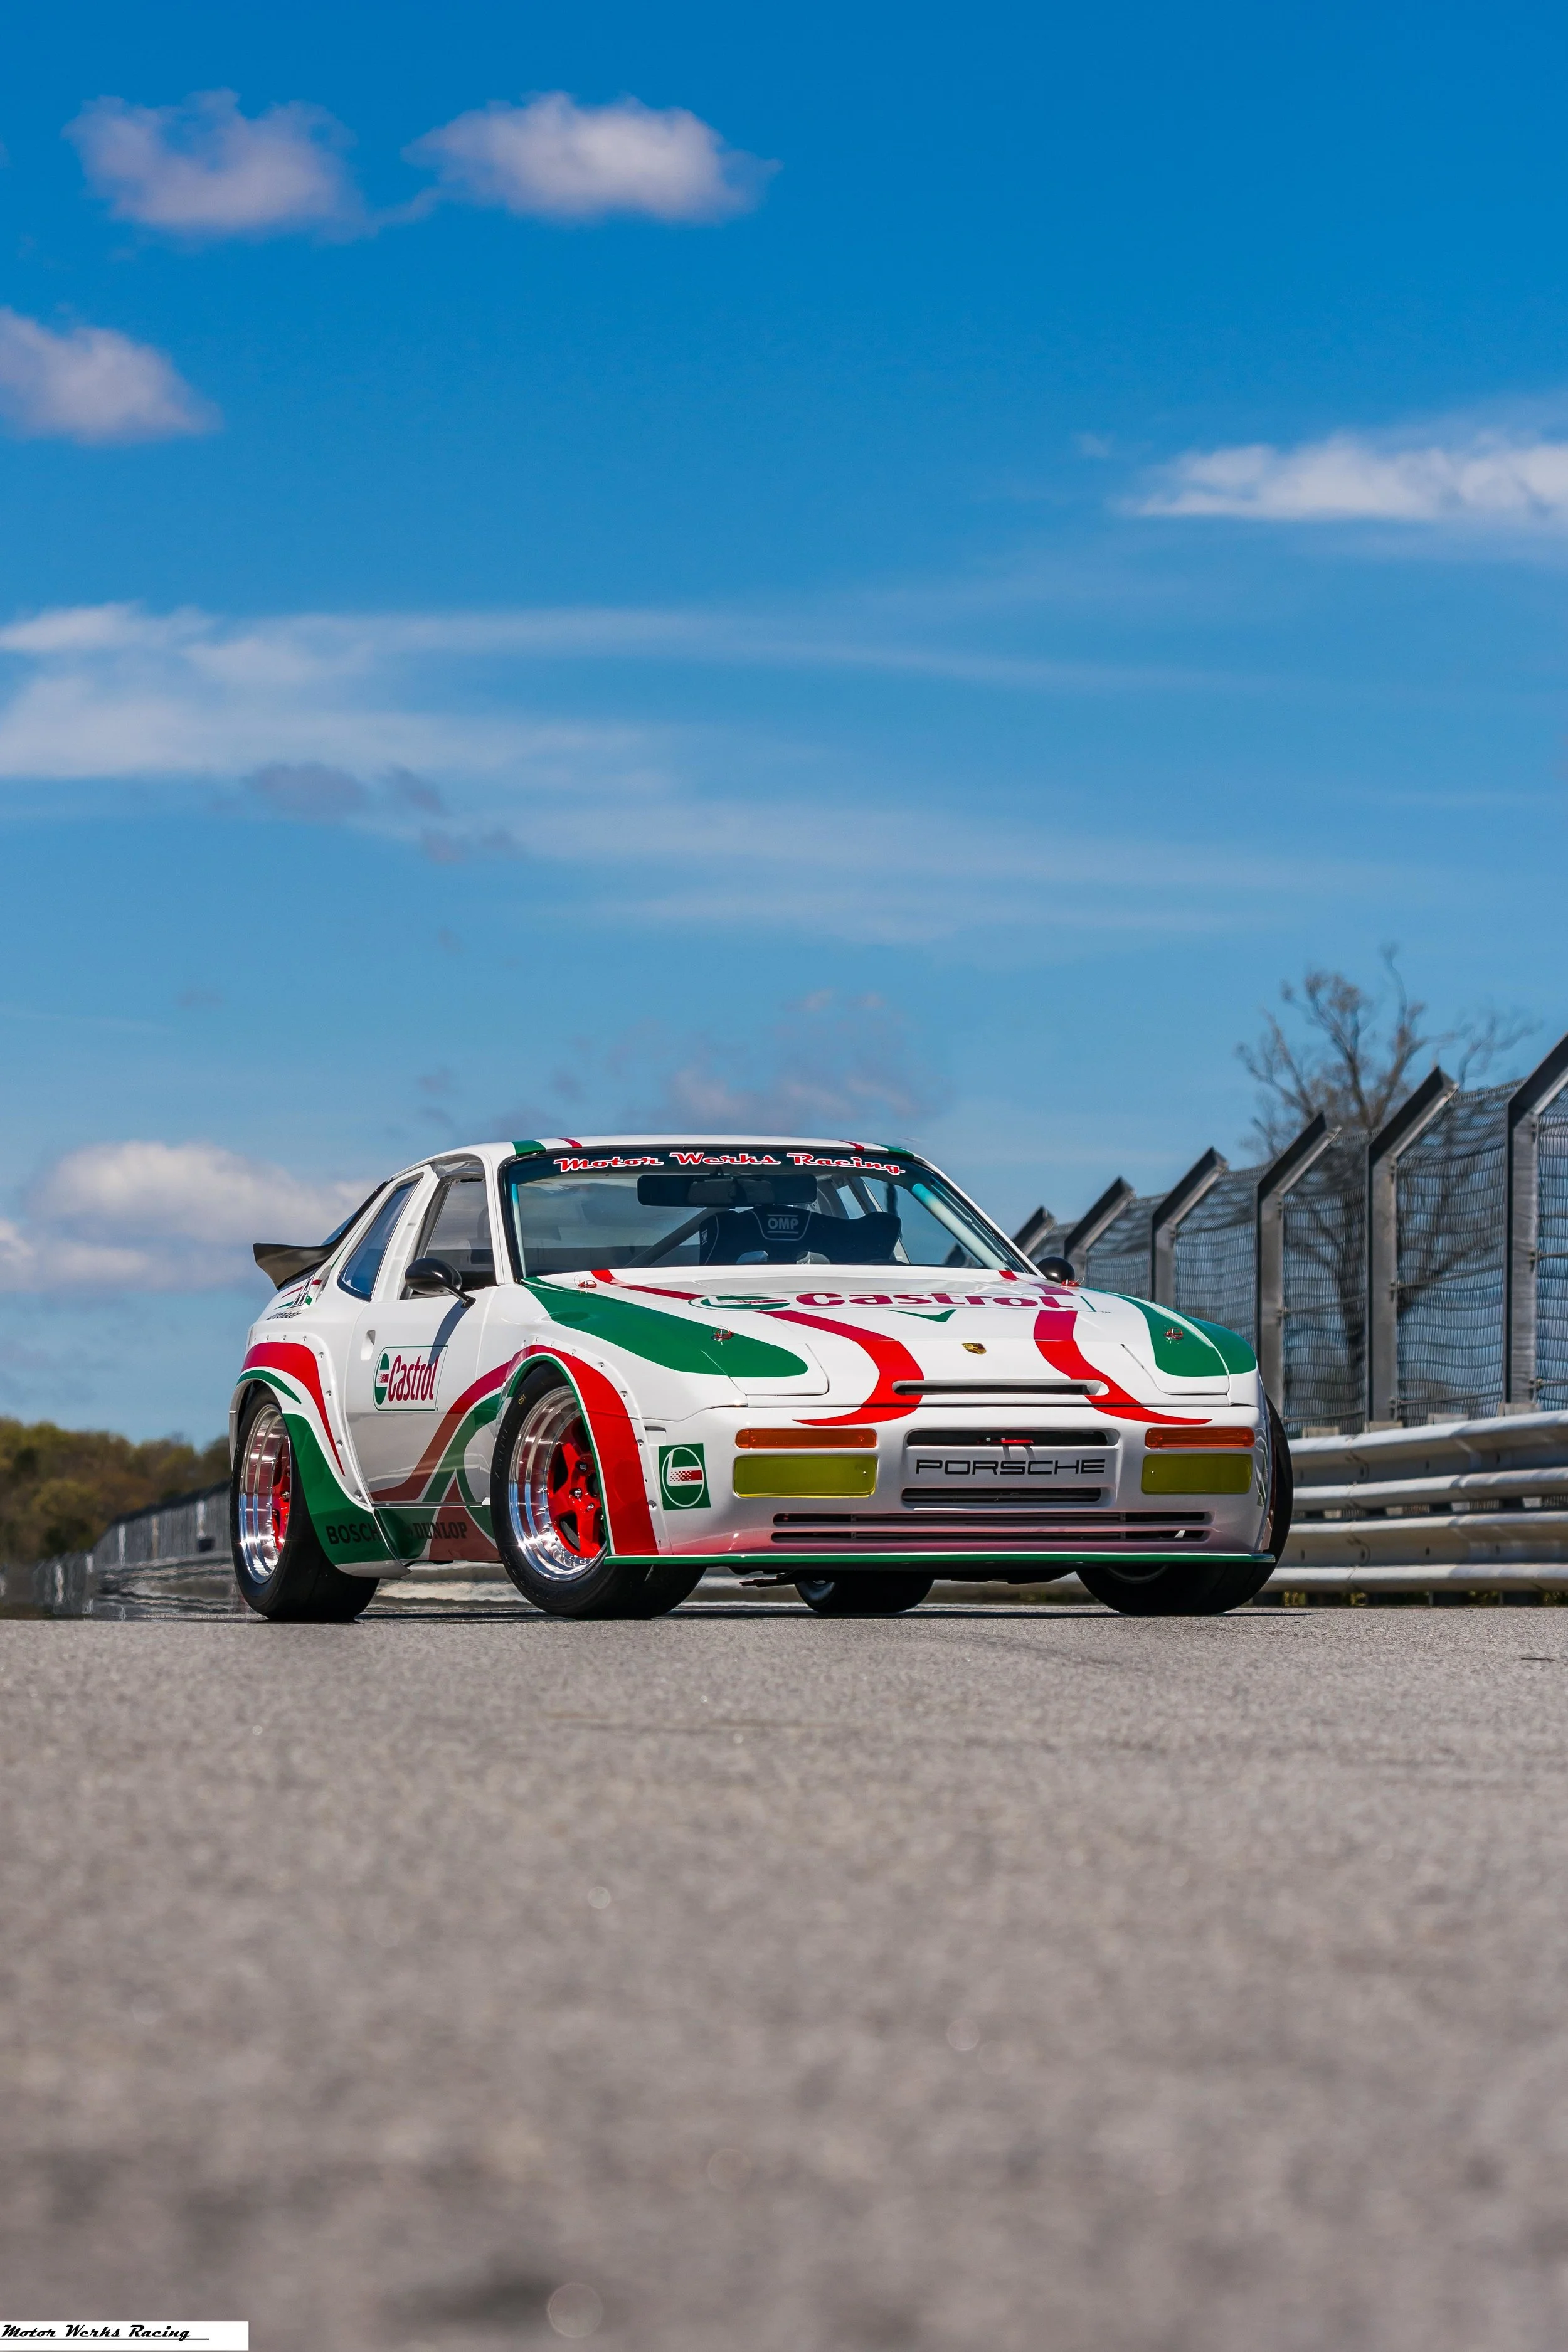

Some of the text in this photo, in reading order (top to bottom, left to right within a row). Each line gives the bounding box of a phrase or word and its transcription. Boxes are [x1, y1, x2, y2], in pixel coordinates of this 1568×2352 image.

[553, 1152, 906, 1176] Motor Werks Racing
[768, 1218, 798, 1230] OMP
[795, 1291, 1073, 1308] Castrol
[388, 1355, 439, 1402] Castrol
[916, 1459, 1106, 1475] PORSCHE
[326, 1522, 381, 1545] BOSCH
[413, 1522, 467, 1539] DUNLOP
